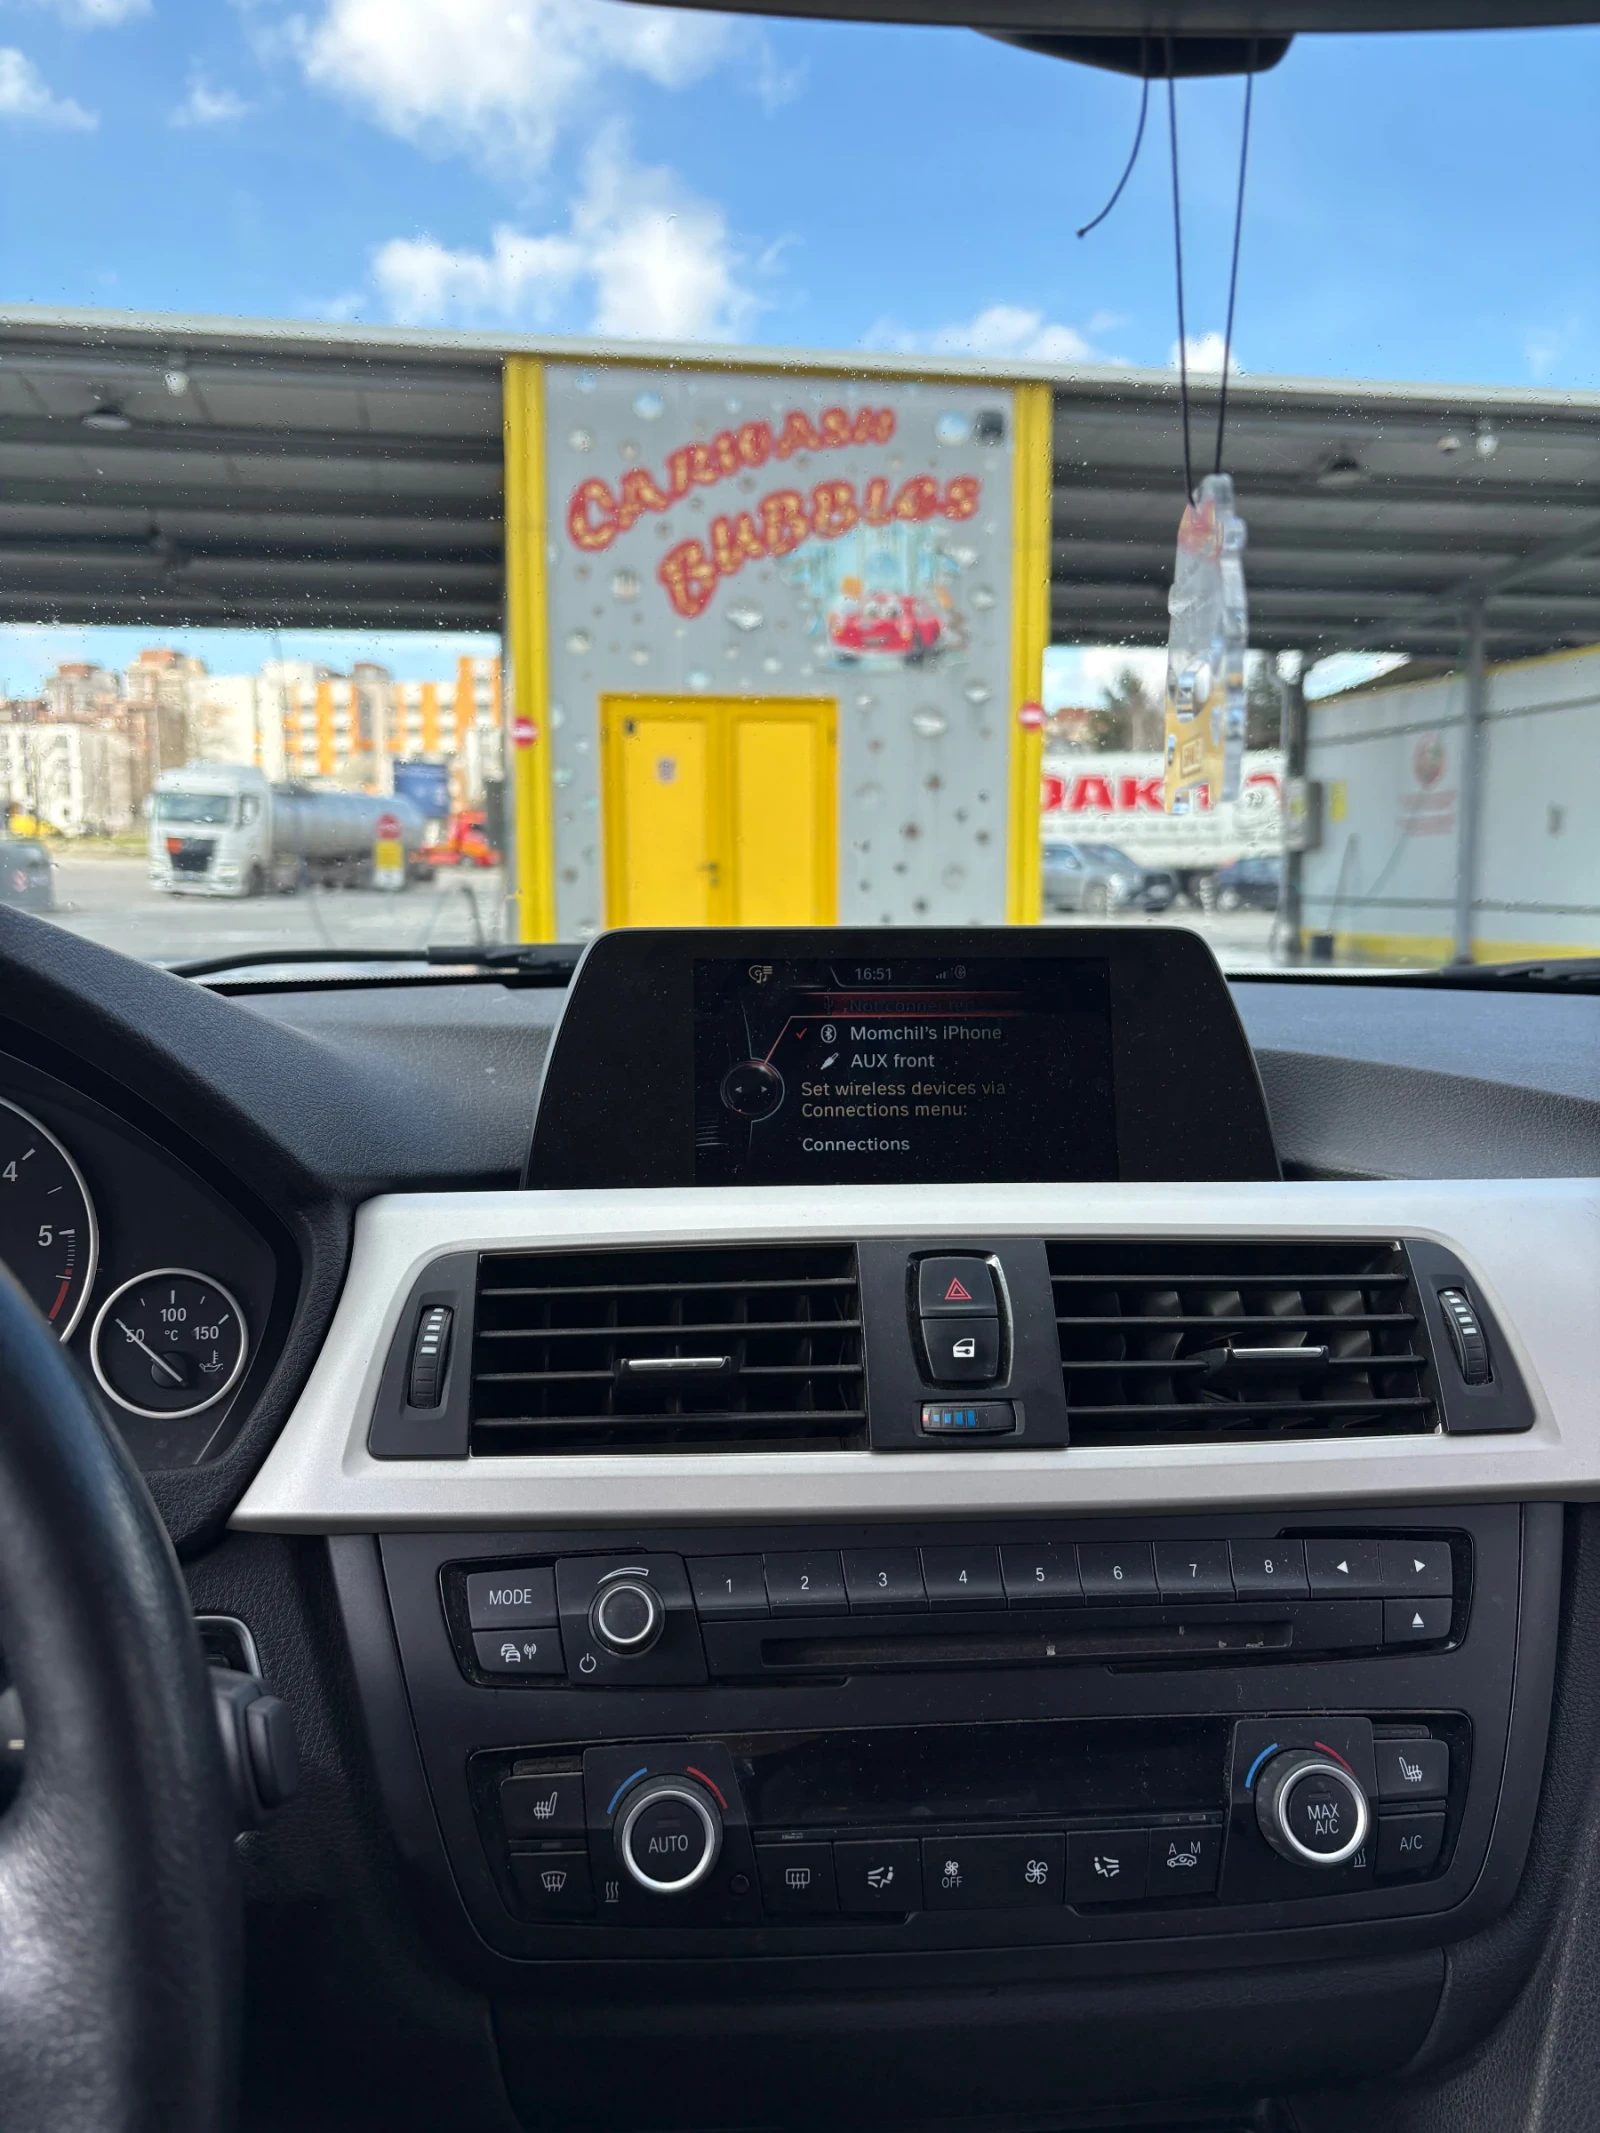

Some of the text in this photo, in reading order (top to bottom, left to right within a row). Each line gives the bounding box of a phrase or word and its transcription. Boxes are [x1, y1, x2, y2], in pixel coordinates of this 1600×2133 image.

[854, 966, 893, 981] 16:51
[850, 1024, 1002, 1041] Momchil's iPhone
[850, 1053, 935, 1069] AUX front
[801, 1081, 1006, 1097] Set wireless devices via
[802, 1102, 967, 1119] Connections menu:
[802, 1136, 911, 1153] Connections
[2, 1160, 19, 1182] 4
[37, 1225, 53, 1248] 5
[160, 1307, 187, 1323] 100
[125, 1328, 146, 1343] 50
[193, 1326, 220, 1341] 150
[1035, 1566, 1046, 1582] 5
[1113, 1564, 1124, 1581] 6
[1188, 1563, 1198, 1578] 7
[1264, 1560, 1275, 1576] 8
[800, 1575, 811, 1592] 2
[878, 1572, 889, 1588] 3
[958, 1568, 969, 1585] 4
[725, 1579, 733, 1594] 1
[488, 1588, 533, 1606] MODE
[1307, 1803, 1341, 1820] MAX
[1314, 1819, 1340, 1836] A/C
[647, 1834, 690, 1855] AUTO
[1168, 1841, 1202, 1856] A M
[1399, 1834, 1424, 1852] A/C
[941, 1876, 963, 1889] OFF
